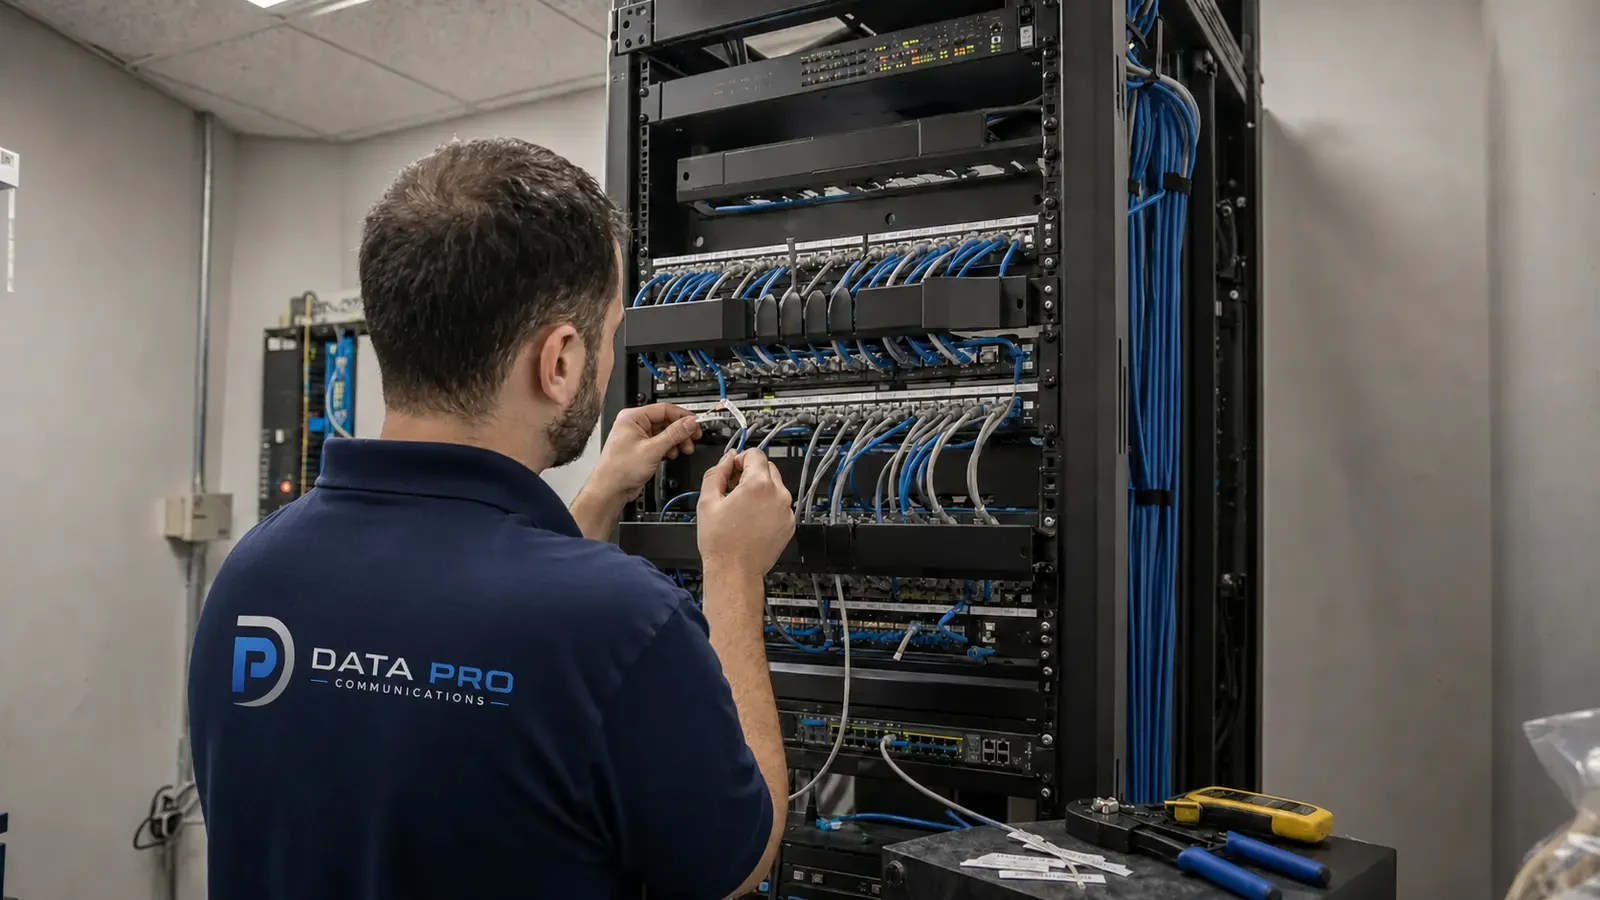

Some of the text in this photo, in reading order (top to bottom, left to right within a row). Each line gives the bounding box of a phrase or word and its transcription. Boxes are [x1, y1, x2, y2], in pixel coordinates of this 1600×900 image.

[311, 647, 514, 694] DATA PRO
[335, 678, 485, 706] COMMUNICATIONS
